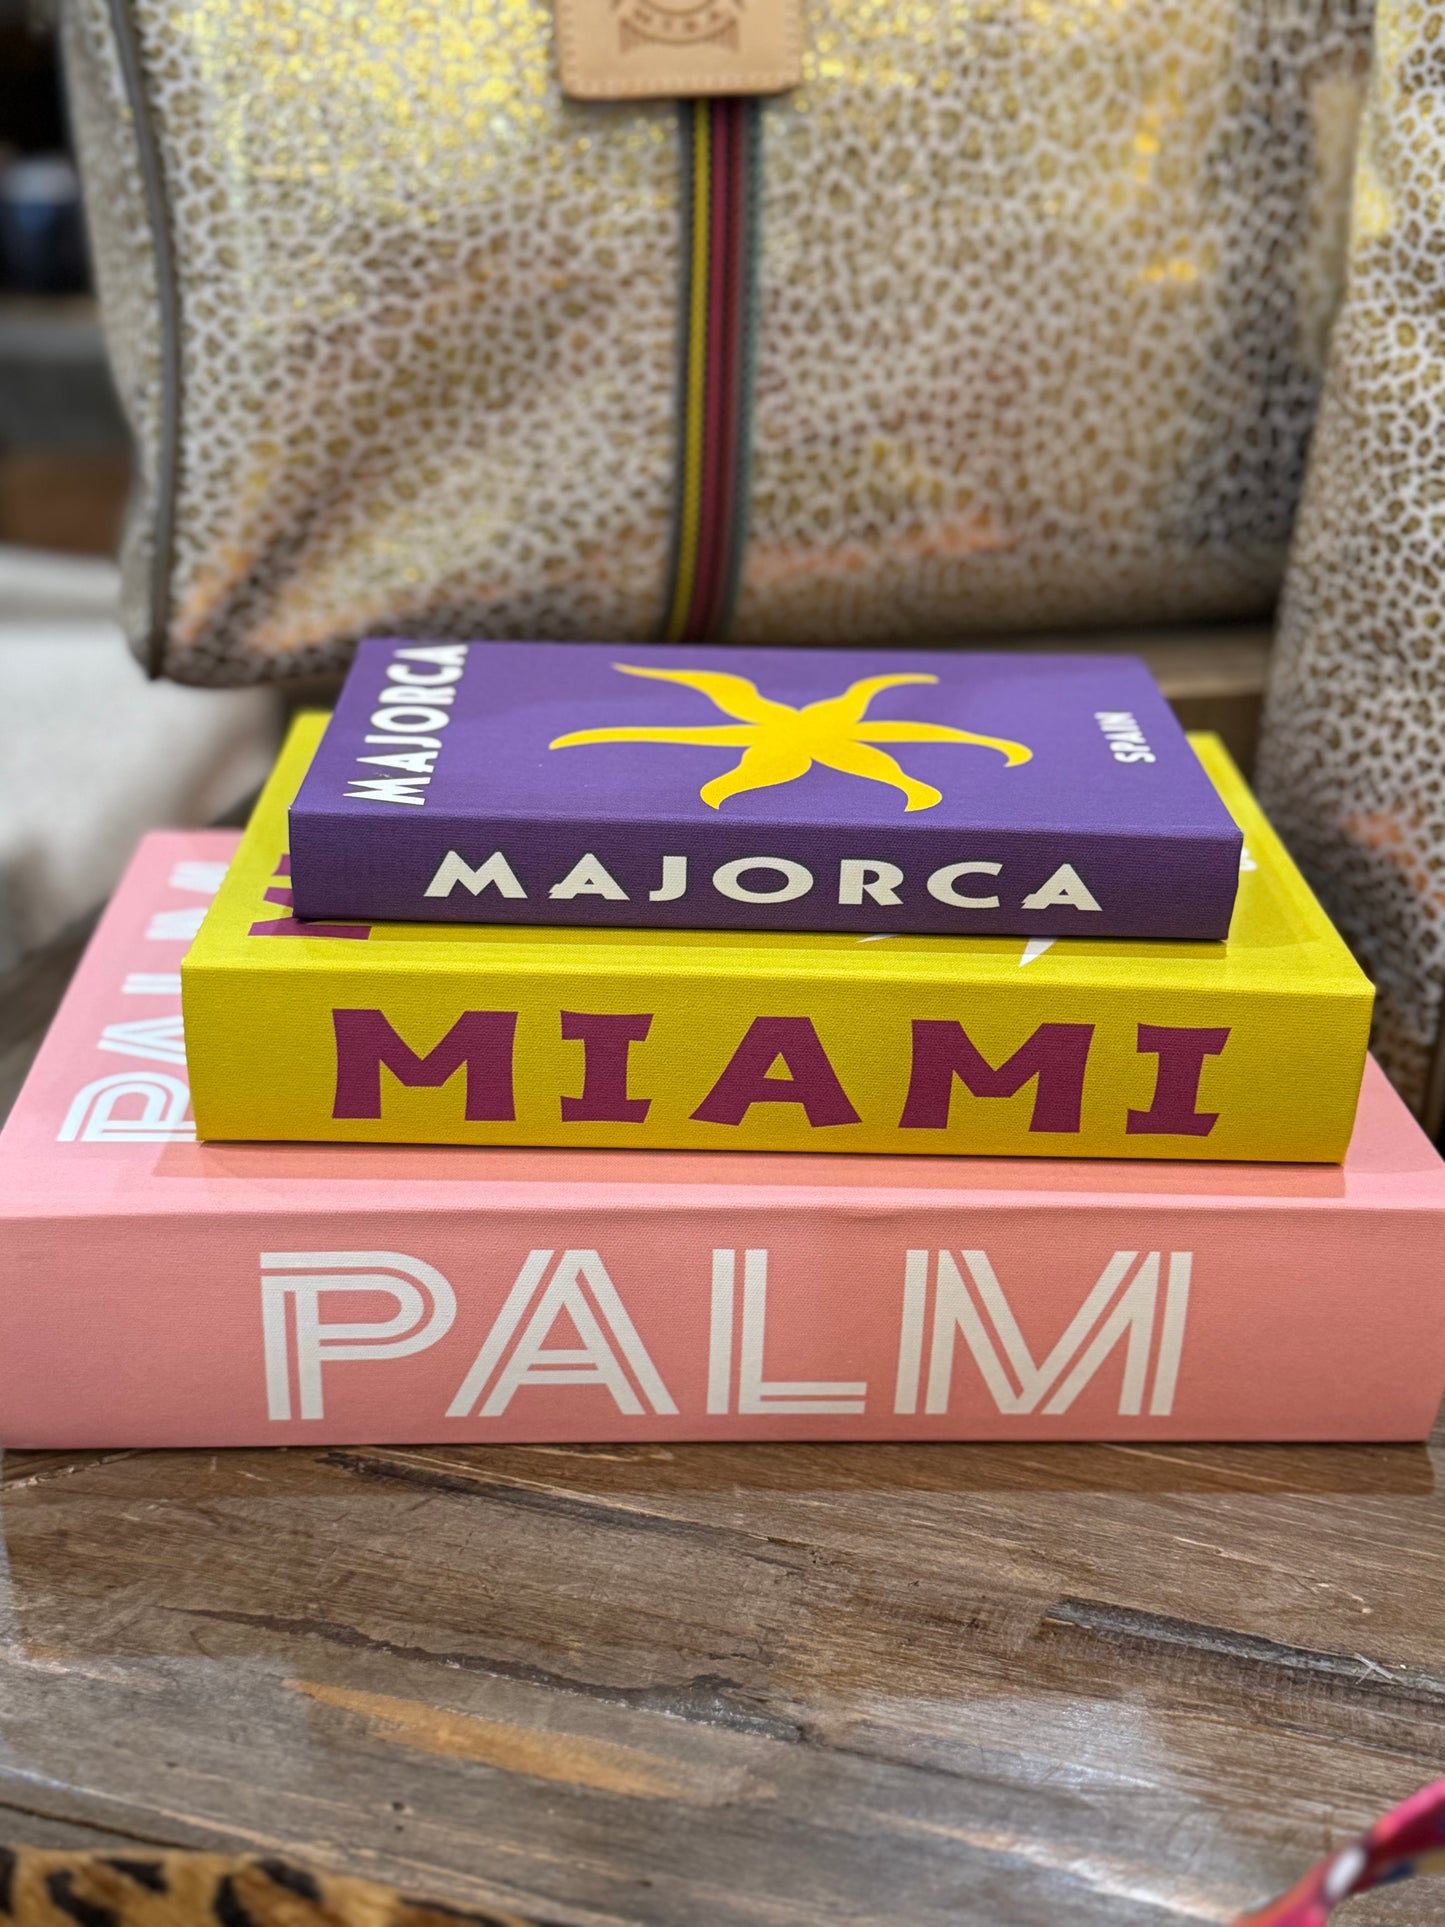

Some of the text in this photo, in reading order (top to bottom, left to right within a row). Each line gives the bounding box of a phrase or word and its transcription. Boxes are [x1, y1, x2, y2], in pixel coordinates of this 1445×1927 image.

[343, 643, 469, 806] MAJORCA
[1093, 711, 1157, 763] SPAIN
[423, 850, 1103, 912] MAJORCA
[331, 1008, 1232, 1137] MIAMI
[258, 1248, 1194, 1421] PALM
